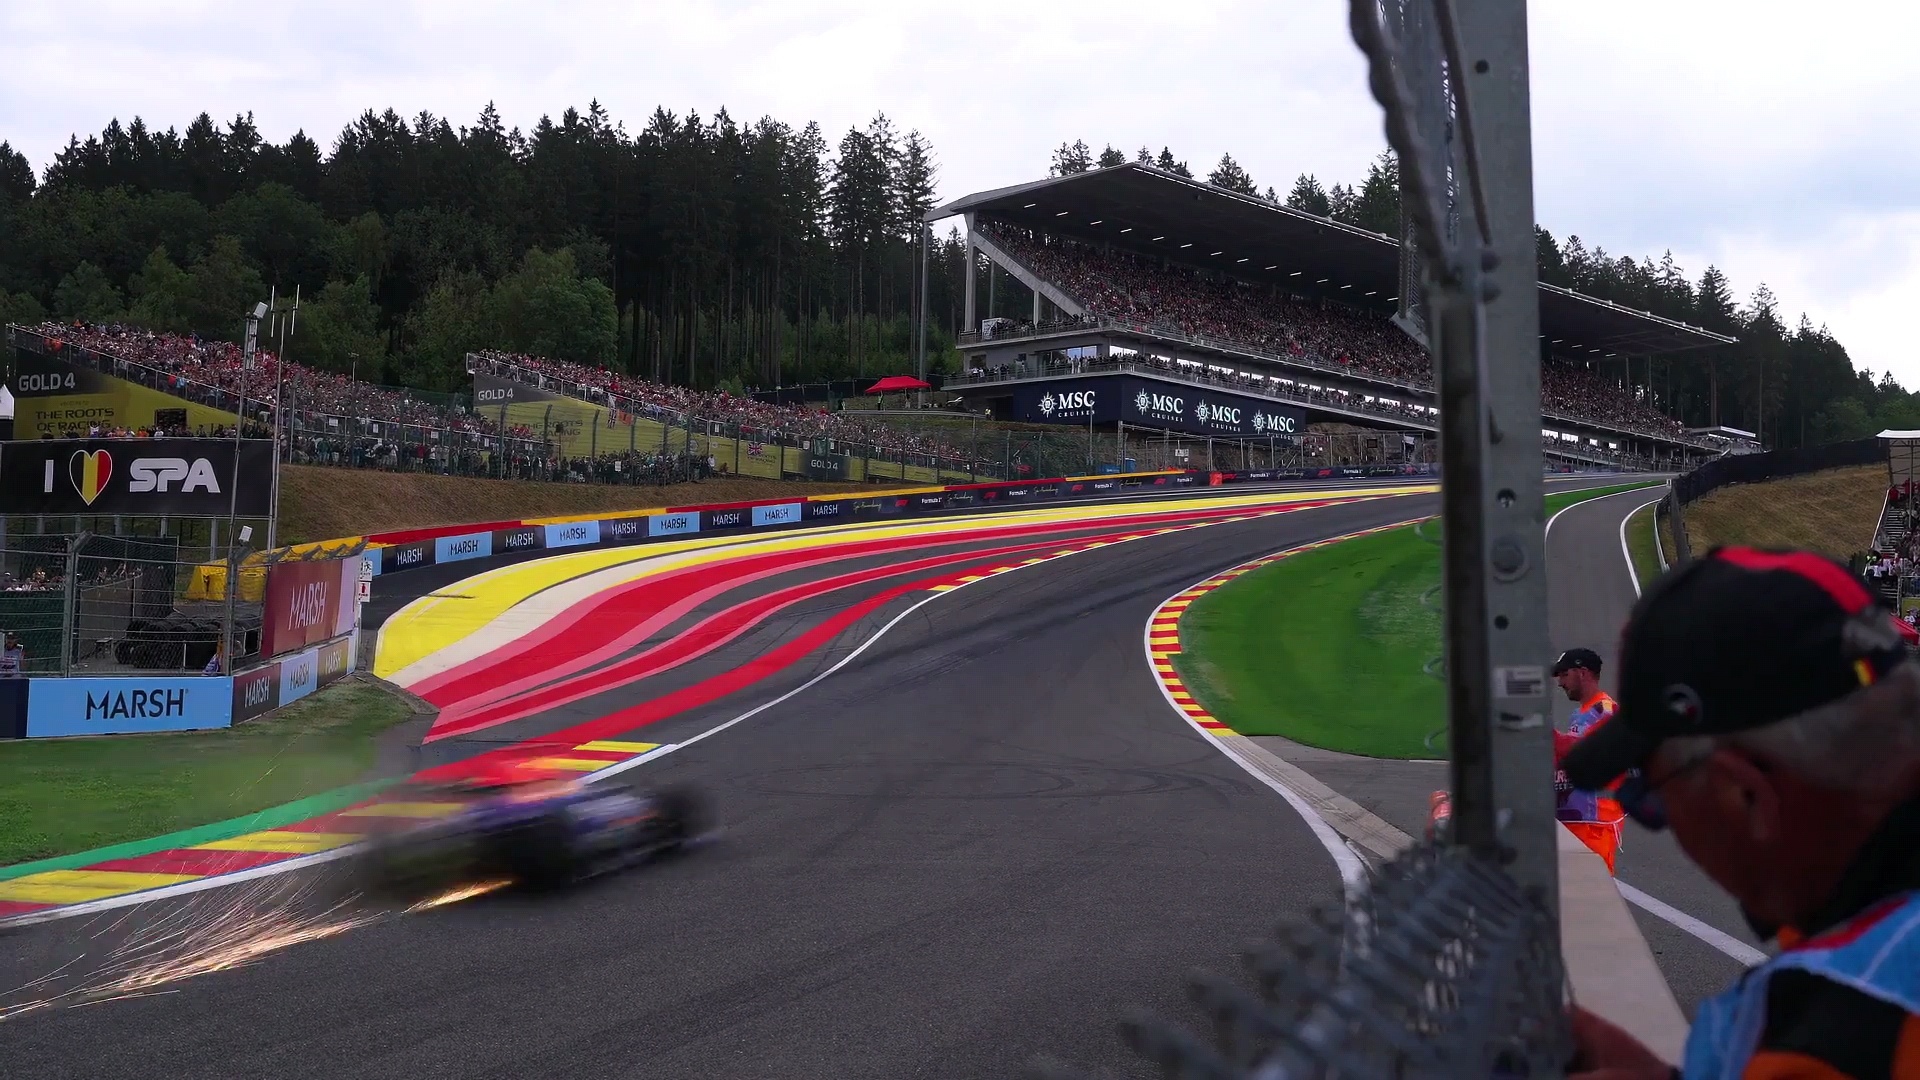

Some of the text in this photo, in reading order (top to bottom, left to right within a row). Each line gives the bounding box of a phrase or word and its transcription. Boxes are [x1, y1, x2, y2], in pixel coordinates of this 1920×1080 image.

[18, 372, 75, 391] GOLD 4
[478, 388, 514, 401] GOLD 4
[1058, 390, 1096, 410] MSC
[1152, 393, 1184, 414] MSC
[36, 408, 114, 420] THE ROOTS
[1211, 404, 1241, 424] MSC
[36, 422, 56, 432] OF
[1267, 414, 1295, 433] MSC
[832, 461, 838, 470] 4
[44, 457, 221, 493] I SPA
[764, 508, 788, 520] MARSH
[813, 504, 838, 516] MARSH
[661, 518, 687, 530] MARSH
[712, 513, 740, 526] MARSH
[559, 528, 587, 541] MARSH
[612, 522, 637, 535] MARSH
[450, 540, 478, 556] MARSH
[505, 533, 534, 548] MARSH
[397, 548, 423, 566] MARSH
[288, 581, 327, 631] MARSH
[244, 676, 270, 708] MARSH
[86, 688, 185, 720] MARSH
